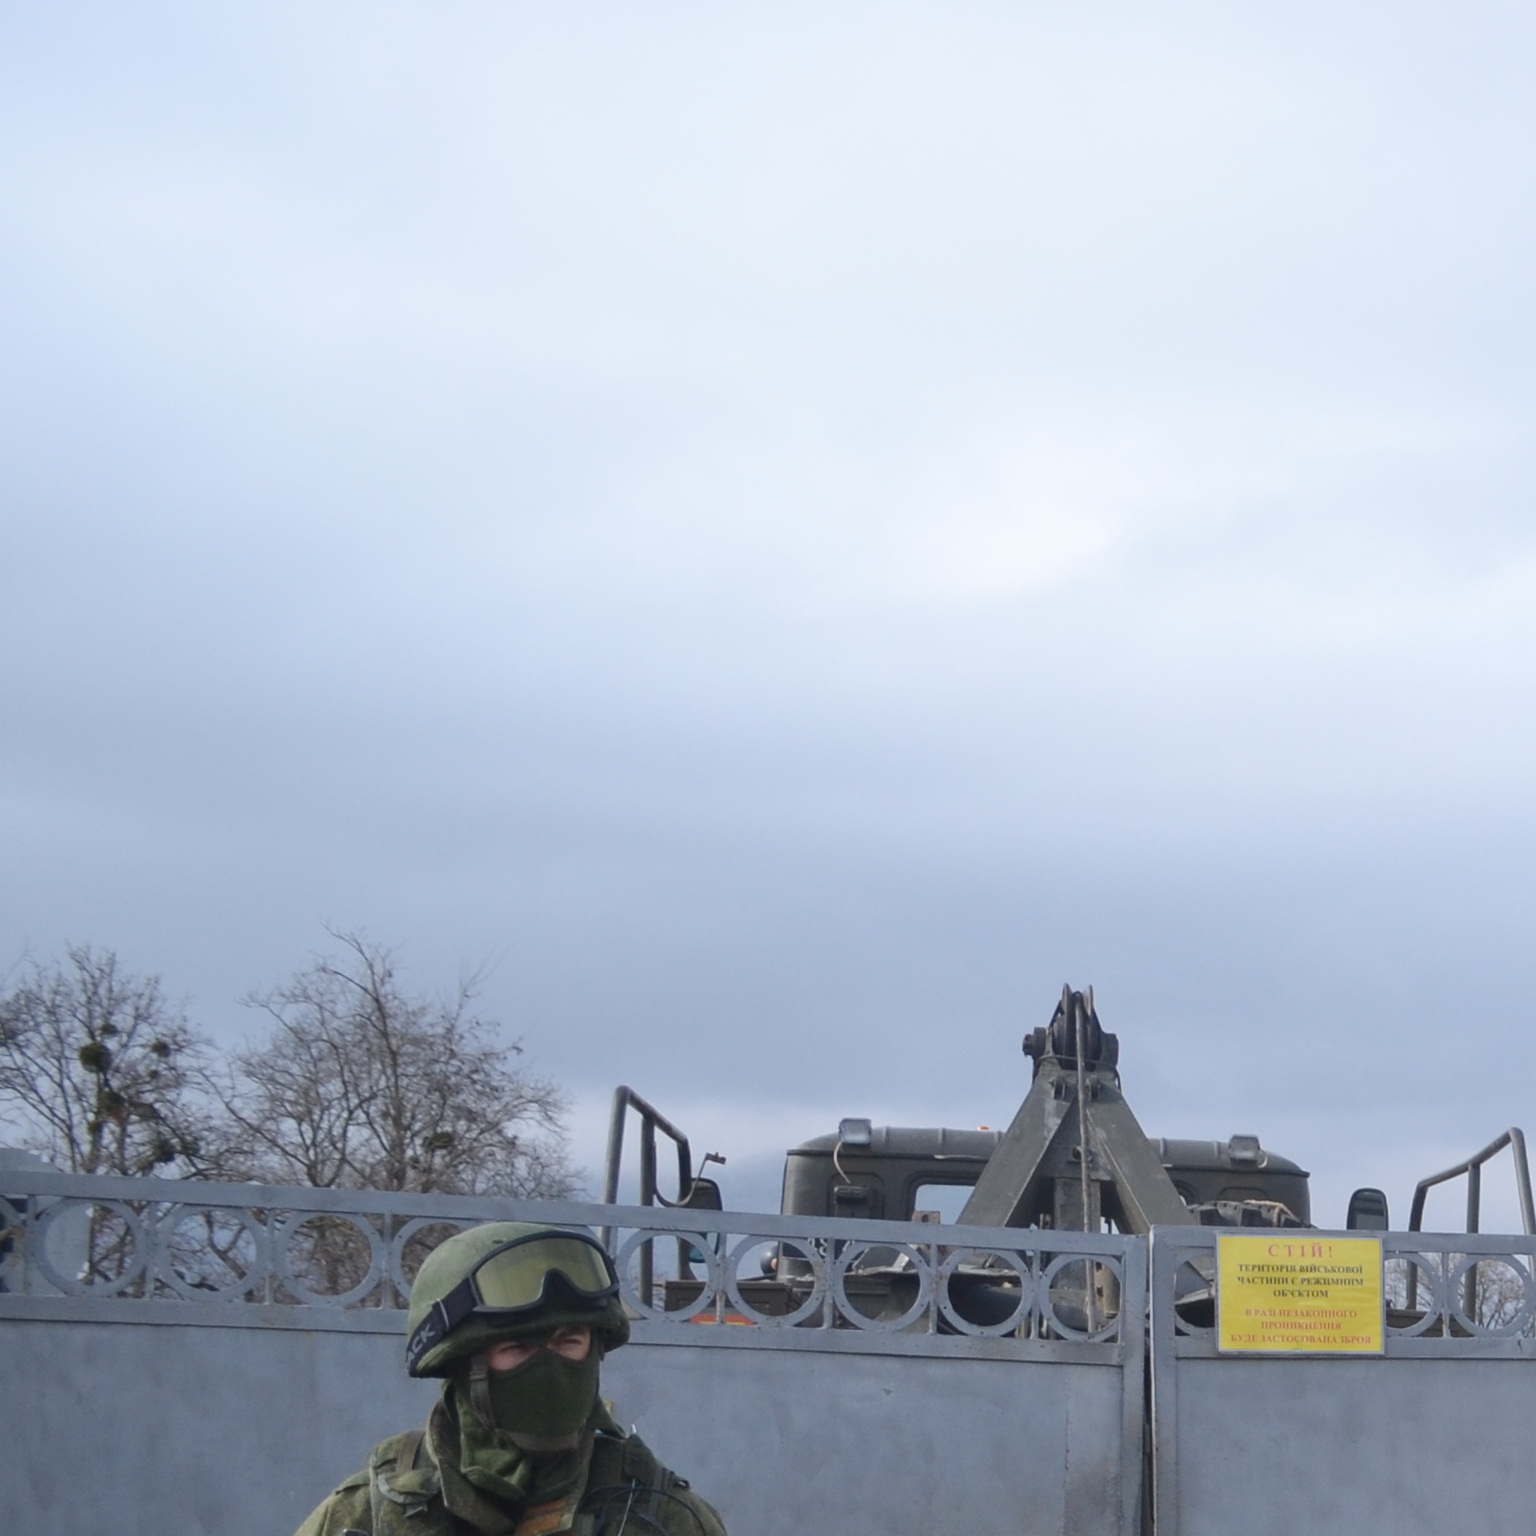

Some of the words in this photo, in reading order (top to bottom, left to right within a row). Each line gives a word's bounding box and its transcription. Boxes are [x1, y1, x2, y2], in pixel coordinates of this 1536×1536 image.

[1267, 1243, 1334, 1258] СТІЙ!
[1238, 1264, 1296, 1273] ТЕРИТОРІЯ
[1299, 1263, 1363, 1274] ВІЙСЬКОВОЇ
[1238, 1276, 1290, 1285] ЧАСТИНИ
[1300, 1277, 1364, 1286] РЕЖИМНИМ
[1245, 1308, 1252, 1317] В
[1254, 1308, 1276, 1317] РАЗІ
[1279, 1309, 1357, 1318] НЕЗАКОННОГО
[1261, 1321, 1341, 1330] ПРОНИКНЕННЯ
[1231, 1334, 1256, 1343] БУДЕ
[1260, 1335, 1337, 1344] ЗАСТОСОВАНА
[1340, 1335, 1371, 1344] ЗБРОЯ
